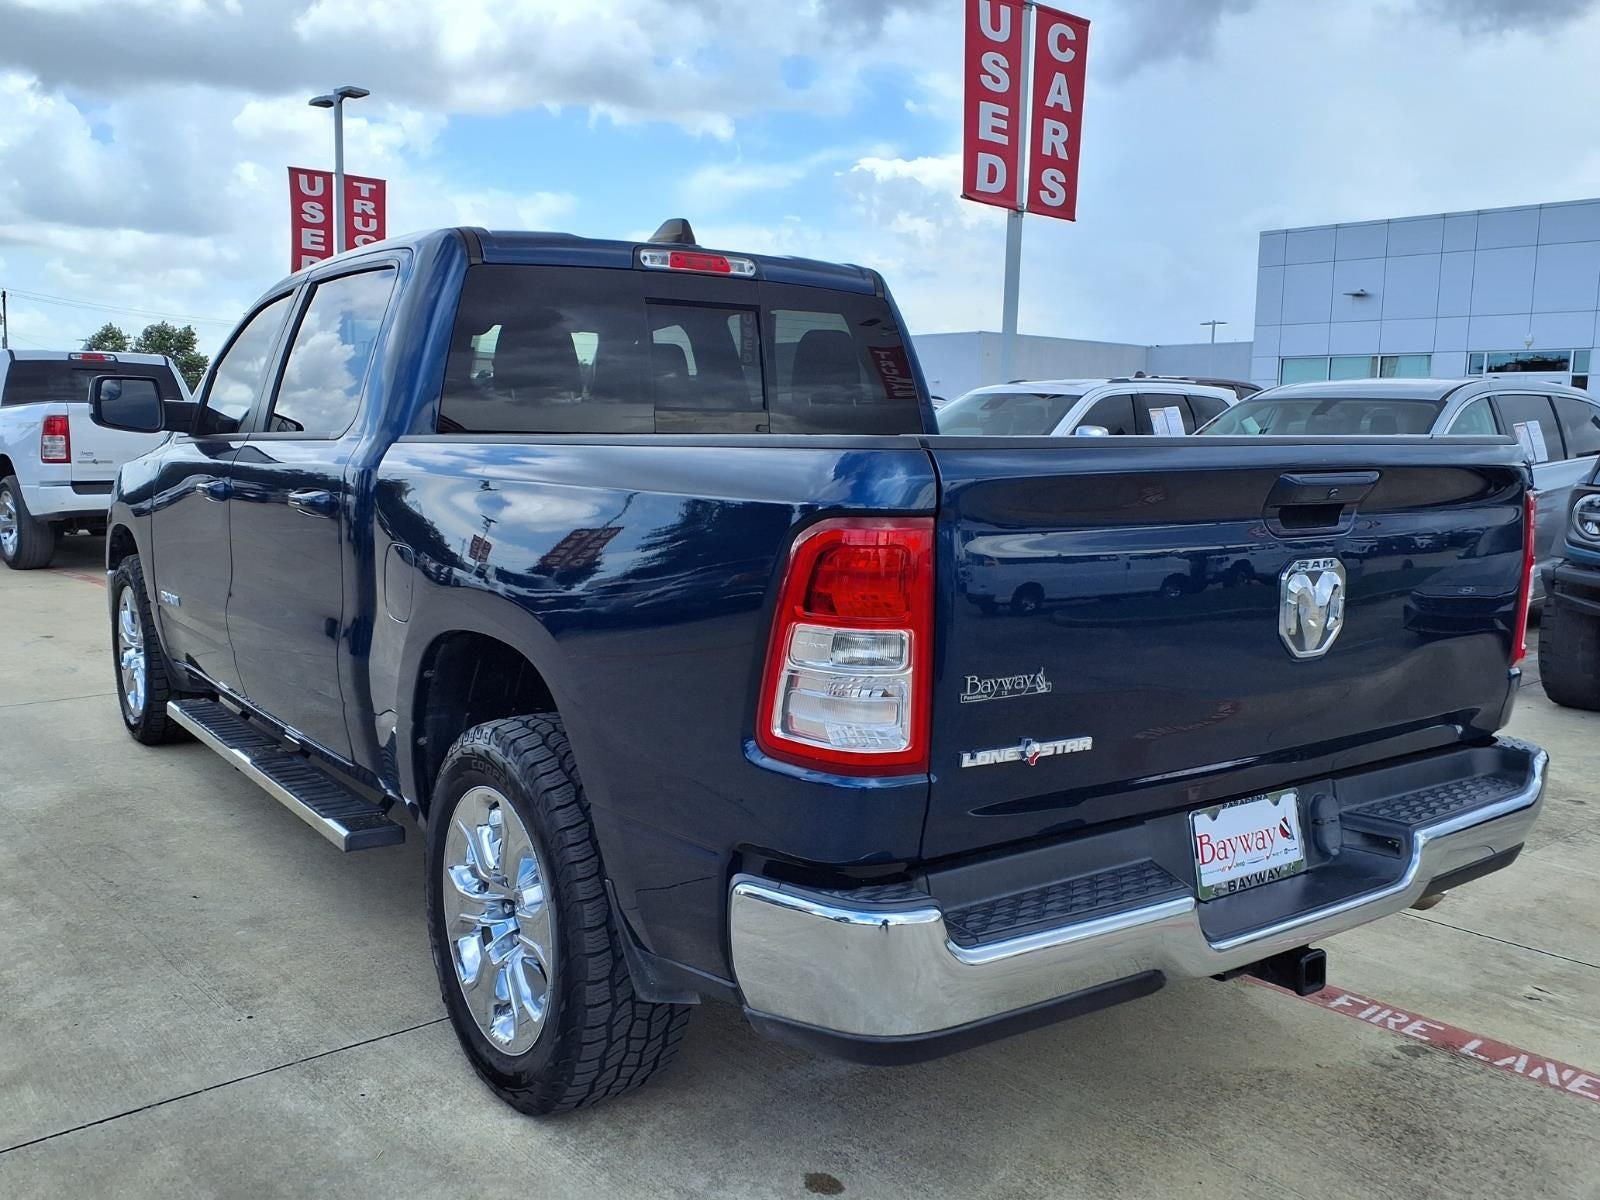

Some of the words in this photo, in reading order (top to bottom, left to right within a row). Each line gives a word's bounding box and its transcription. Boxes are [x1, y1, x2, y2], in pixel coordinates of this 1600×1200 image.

[976, 0, 1011, 194] USED
[1039, 23, 1077, 207] CARS
[1298, 560, 1334, 570] RAM
[964, 673, 1035, 700] Bayway
[961, 747, 1022, 768] LONE
[1040, 736, 1093, 757] STAR
[1196, 826, 1277, 871] Bayway
[1227, 867, 1282, 893] BAYWAY
[1328, 994, 1445, 1041] FIRE
[1458, 1039, 1600, 1100] LANE
